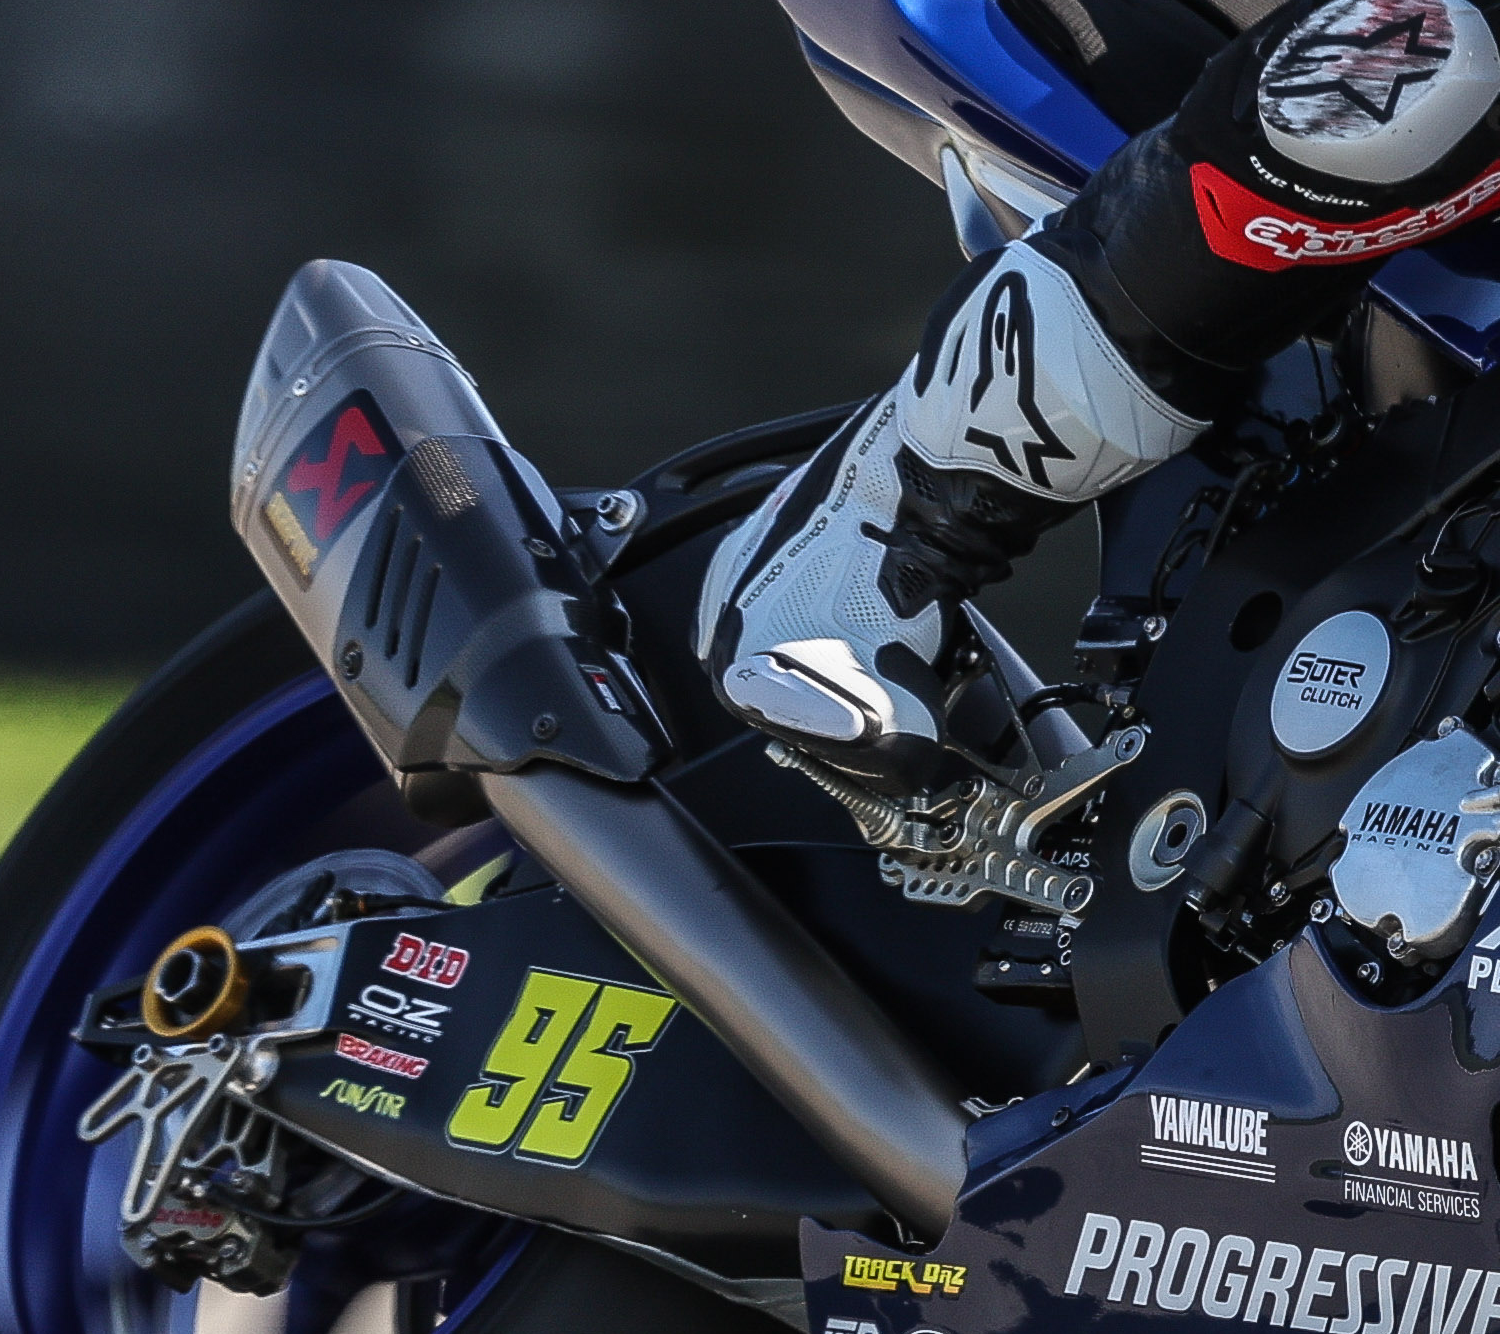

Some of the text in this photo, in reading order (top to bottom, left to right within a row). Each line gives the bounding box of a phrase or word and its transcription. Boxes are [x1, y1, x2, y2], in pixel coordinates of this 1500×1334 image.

[1287, 652, 1366, 689] SUTER
[1300, 686, 1362, 710] CLUTCH
[1351, 833, 1454, 855] RACING
[1360, 802, 1460, 845] YAMAHA
[336, 1033, 430, 1079] BRAKING
[447, 967, 682, 1167] 95
[1150, 1095, 1269, 1156] YAMALUBE
[1373, 1128, 1478, 1181] YAMAHA
[1344, 1180, 1480, 1218] FINANCIAL SERVICES
[843, 1255, 931, 1294] TRACK
